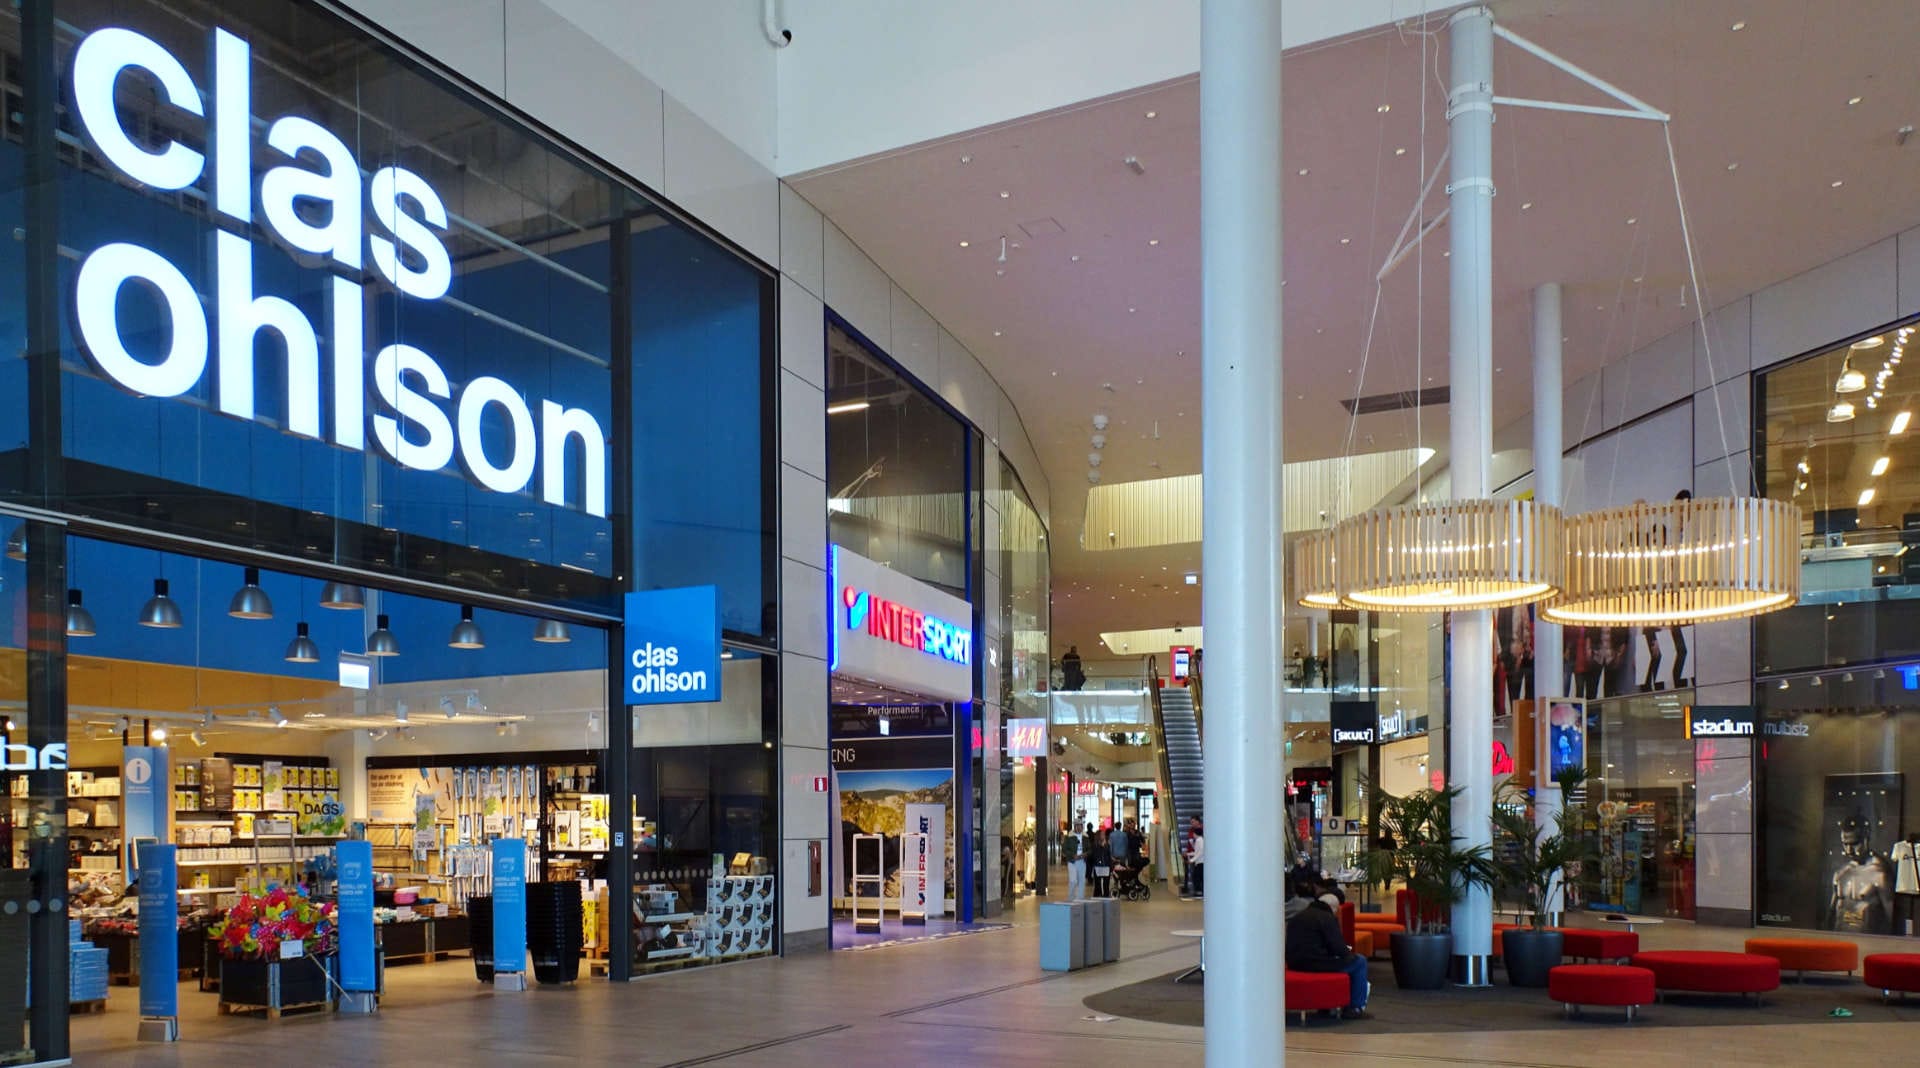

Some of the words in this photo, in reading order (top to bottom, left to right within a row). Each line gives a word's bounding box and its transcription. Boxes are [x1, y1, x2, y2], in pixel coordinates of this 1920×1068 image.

[74, 26, 453, 300] clas
[76, 228, 606, 518] ohlson
[868, 594, 971, 665] INTERSPORT
[632, 642, 679, 668] clas
[632, 667, 707, 694] ohlson
[867, 705, 920, 715] Performance
[1693, 719, 1754, 735] stadium
[304, 803, 340, 815] DAGS
